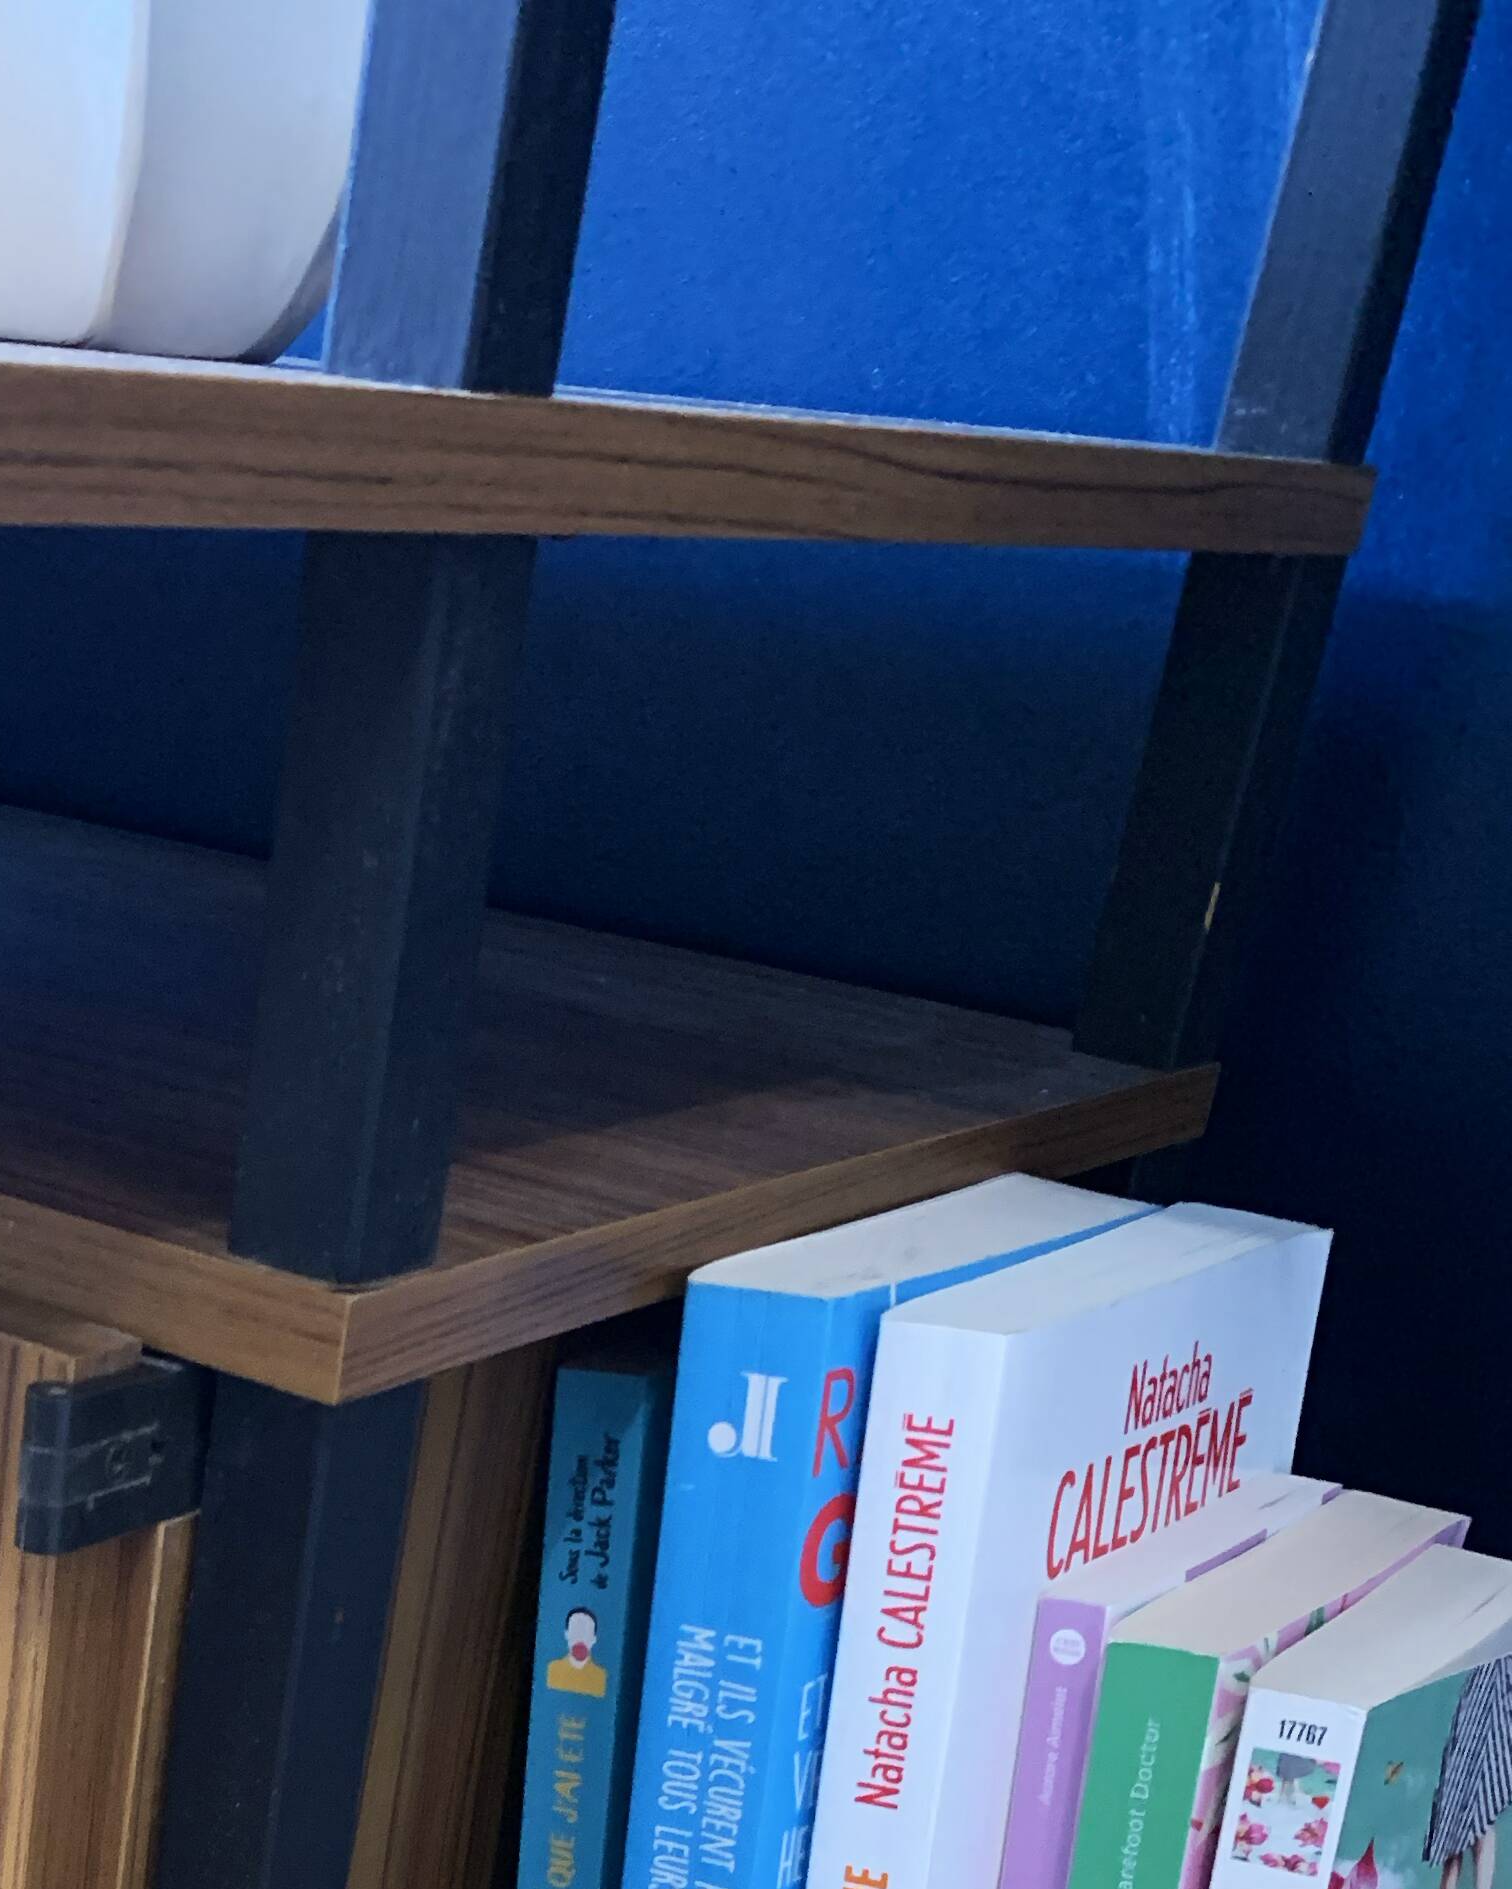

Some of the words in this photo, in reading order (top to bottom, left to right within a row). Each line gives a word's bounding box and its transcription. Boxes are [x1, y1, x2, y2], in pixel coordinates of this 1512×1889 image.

[1123, 1340, 1213, 1435] Natacha
[590, 1432, 620, 1506] Parker
[585, 1514, 612, 1568] Jack
[667, 1623, 716, 1736] MALGRÉ
[722, 1634, 763, 1669] ET
[718, 1672, 757, 1725] ILS
[1277, 1718, 1329, 1747] 17767
[853, 1665, 919, 1811] Natacha
[1129, 1715, 1161, 1800] Doctor
[659, 1746, 704, 1812] TOUS
[702, 1728, 753, 1877] VÉCURENT
[546, 1831, 575, 1888] QUE
